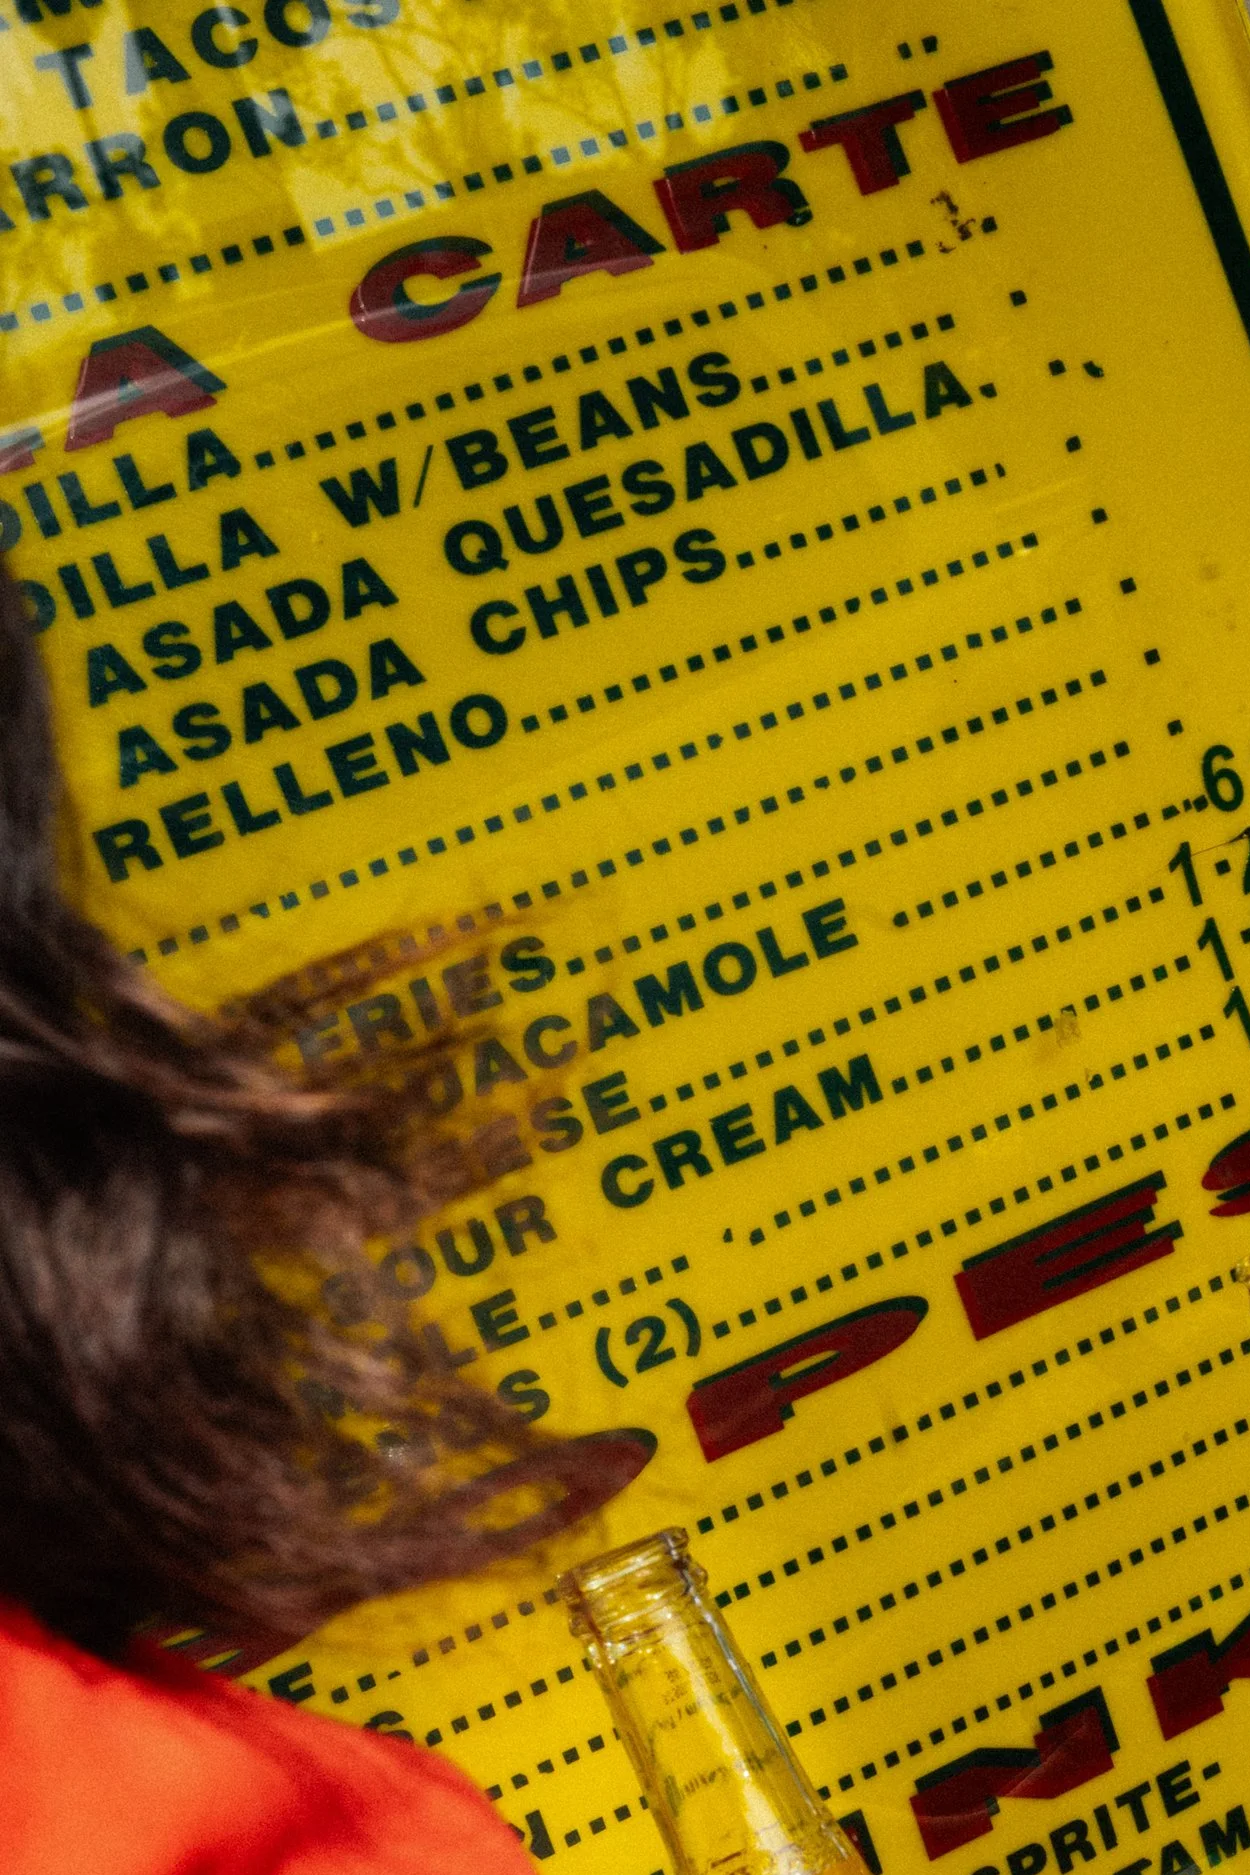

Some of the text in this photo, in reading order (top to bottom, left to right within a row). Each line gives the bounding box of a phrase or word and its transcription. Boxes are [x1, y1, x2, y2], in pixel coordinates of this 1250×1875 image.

[0, 87, 306, 232] RRON
[349, 50, 1073, 344] CARTE
[318, 351, 742, 530] W/BEANS
[85, 556, 400, 708] ASADA
[115, 527, 728, 790] ASADA CHIPS
[91, 693, 509, 884] RELLENO
[599, 1053, 886, 1209] CREAM
[594, 1296, 702, 1389] (2)
